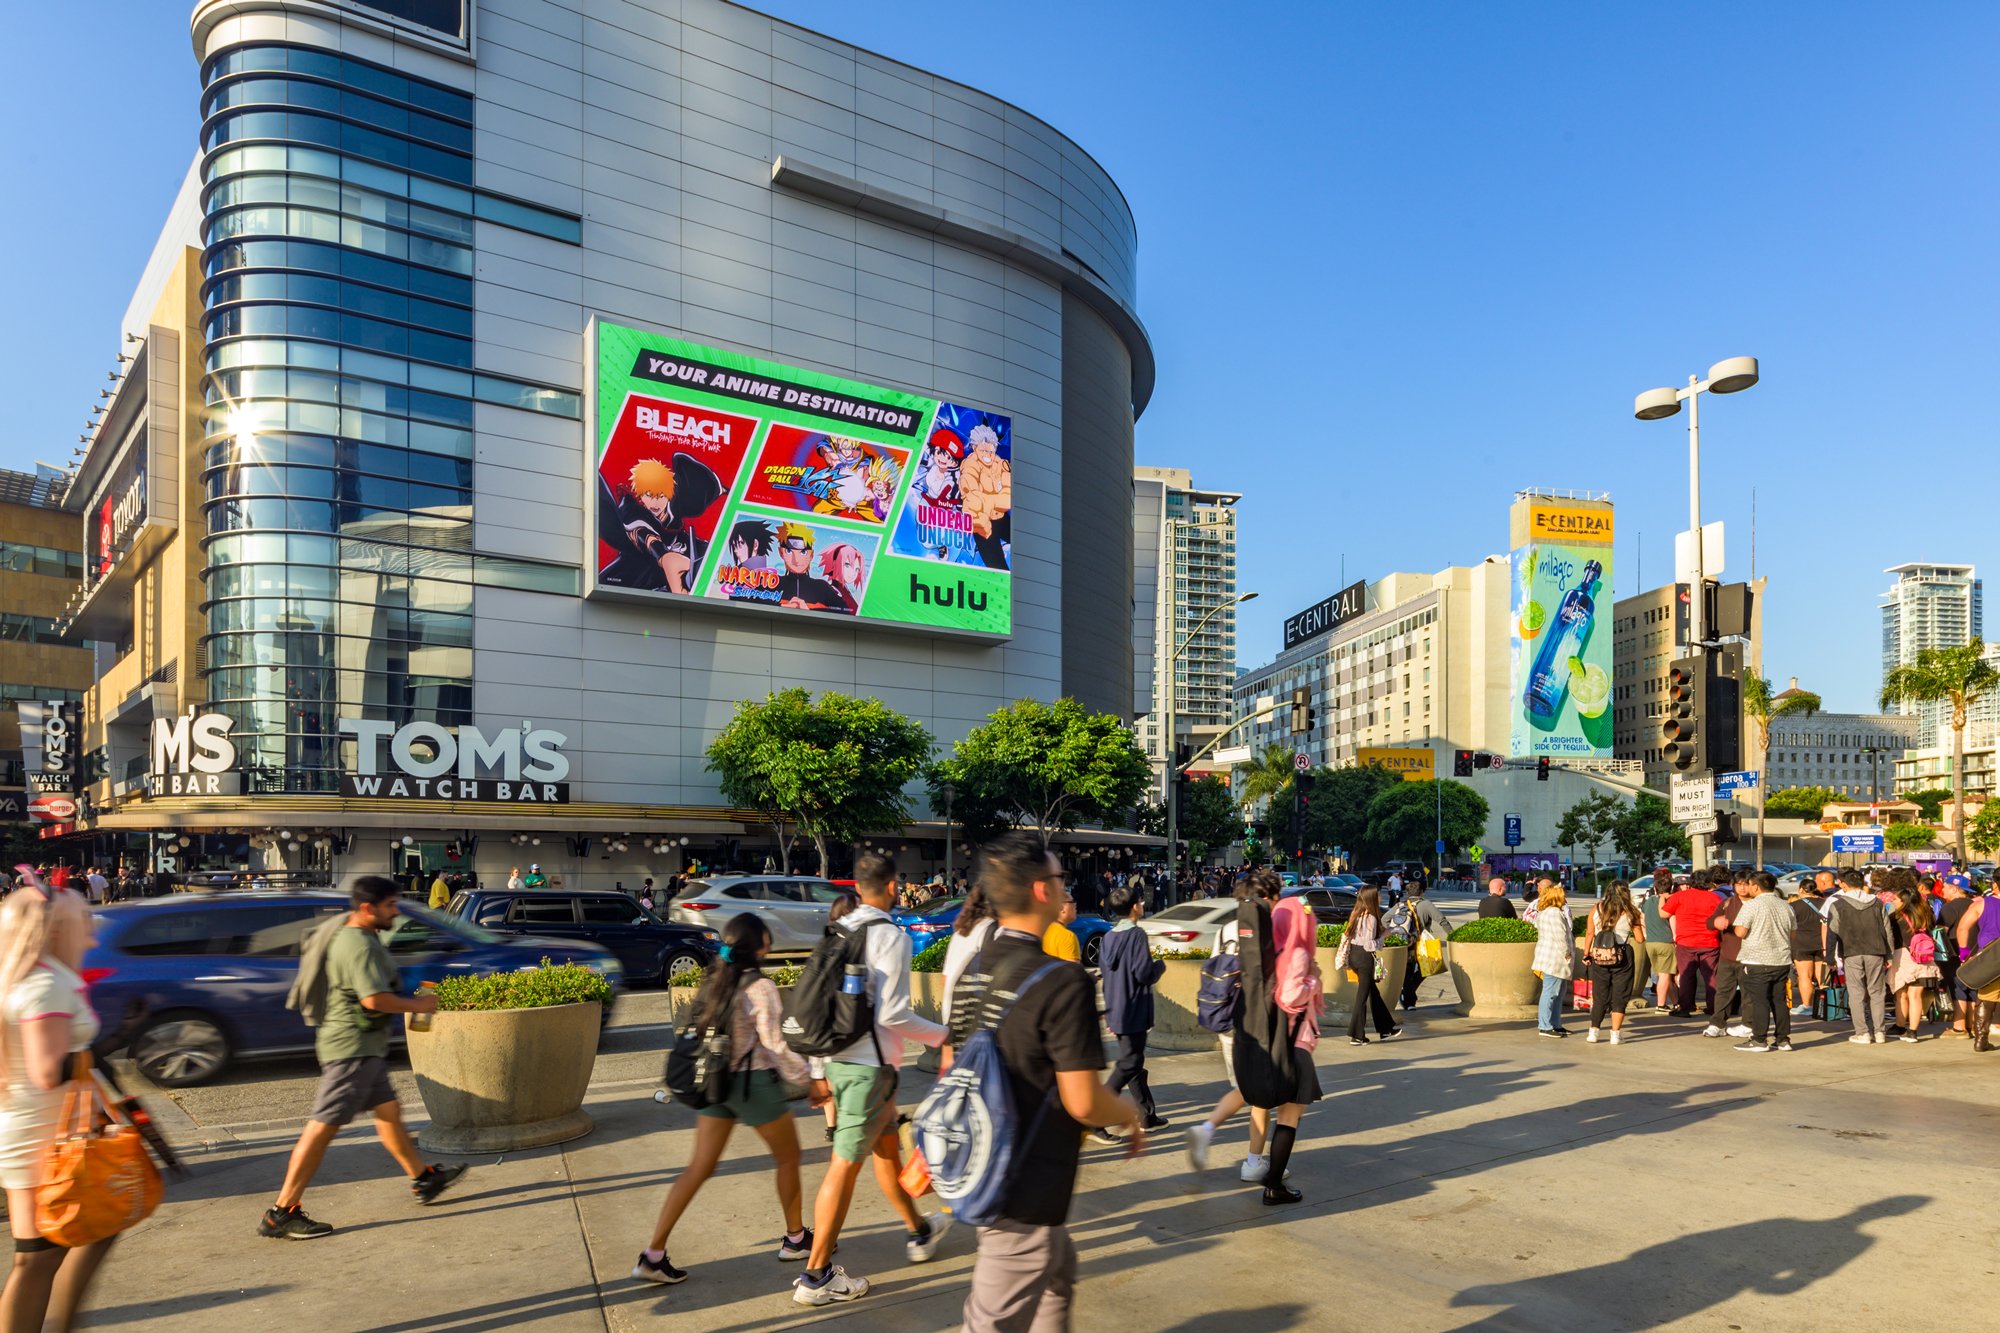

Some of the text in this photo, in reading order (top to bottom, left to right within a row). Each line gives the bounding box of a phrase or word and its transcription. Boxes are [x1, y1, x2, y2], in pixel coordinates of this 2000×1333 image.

[649, 358, 912, 429] YOUR ANIME DESTINATION
[636, 406, 731, 445] BLEACH
[763, 465, 807, 475] DRAGON
[768, 474, 791, 484] BALL
[113, 469, 146, 545] TOYOTA
[938, 500, 953, 508] hulu
[918, 504, 973, 532] UNDEAD
[918, 524, 973, 551] UNLUCK
[718, 563, 780, 589] NARUTO
[910, 573, 988, 612] hulu
[46, 700, 69, 770] TOM'S
[1550, 736, 1583, 744] BRIGHTER
[339, 718, 570, 783] TOM'S
[30, 774, 70, 783] WATCH
[38, 783, 61, 791] BAR
[172, 774, 220, 794] BAR
[352, 777, 558, 802] WATCH BAR
[1674, 779, 1691, 788] RIGHT
[1679, 791, 1704, 800] MUST
[1692, 804, 1710, 812] RIGHT
